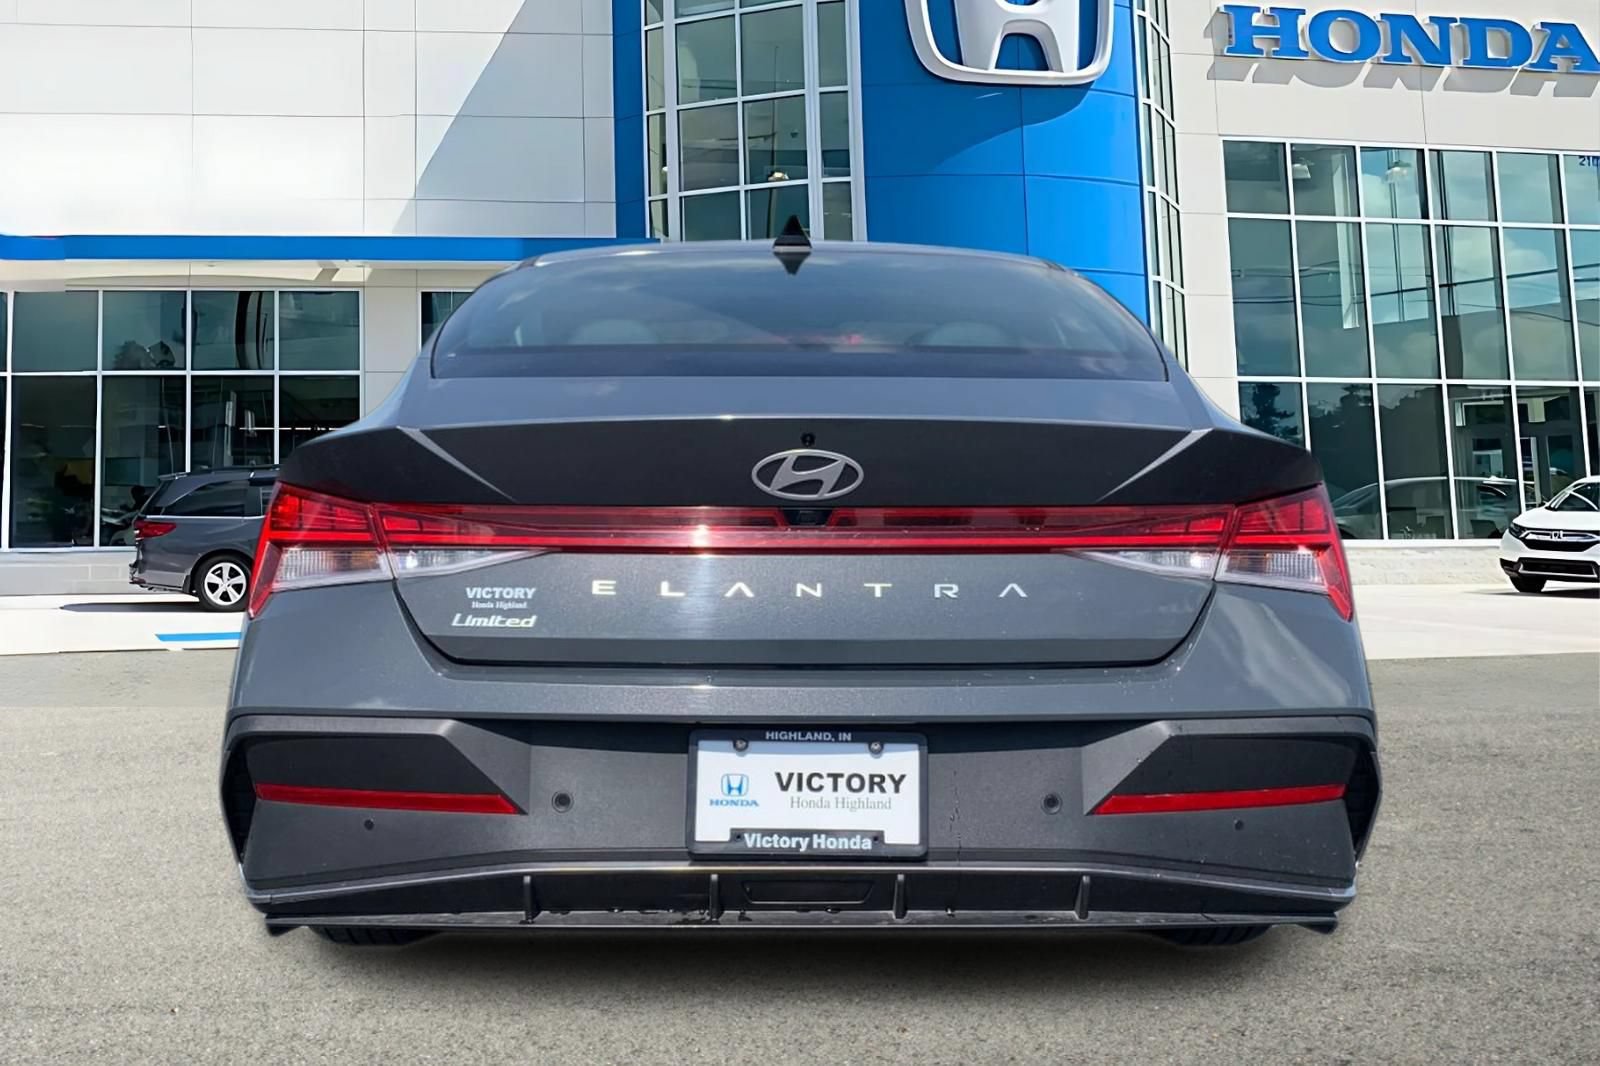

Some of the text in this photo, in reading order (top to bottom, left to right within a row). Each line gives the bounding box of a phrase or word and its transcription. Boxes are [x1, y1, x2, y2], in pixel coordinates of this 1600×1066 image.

[1221, 4, 1600, 73] HONDA
[465, 587, 536, 599] VICTORY
[591, 579, 1029, 599] ELANTRA
[472, 601, 527, 610] Honda Highland
[451, 613, 537, 628] Limited
[765, 731, 852, 742] HIGHLAND, IN
[775, 772, 907, 793] VICTORY
[709, 798, 759, 807] HONDA
[790, 796, 892, 813] Honda Highland
[743, 833, 873, 852] Victory Honda
